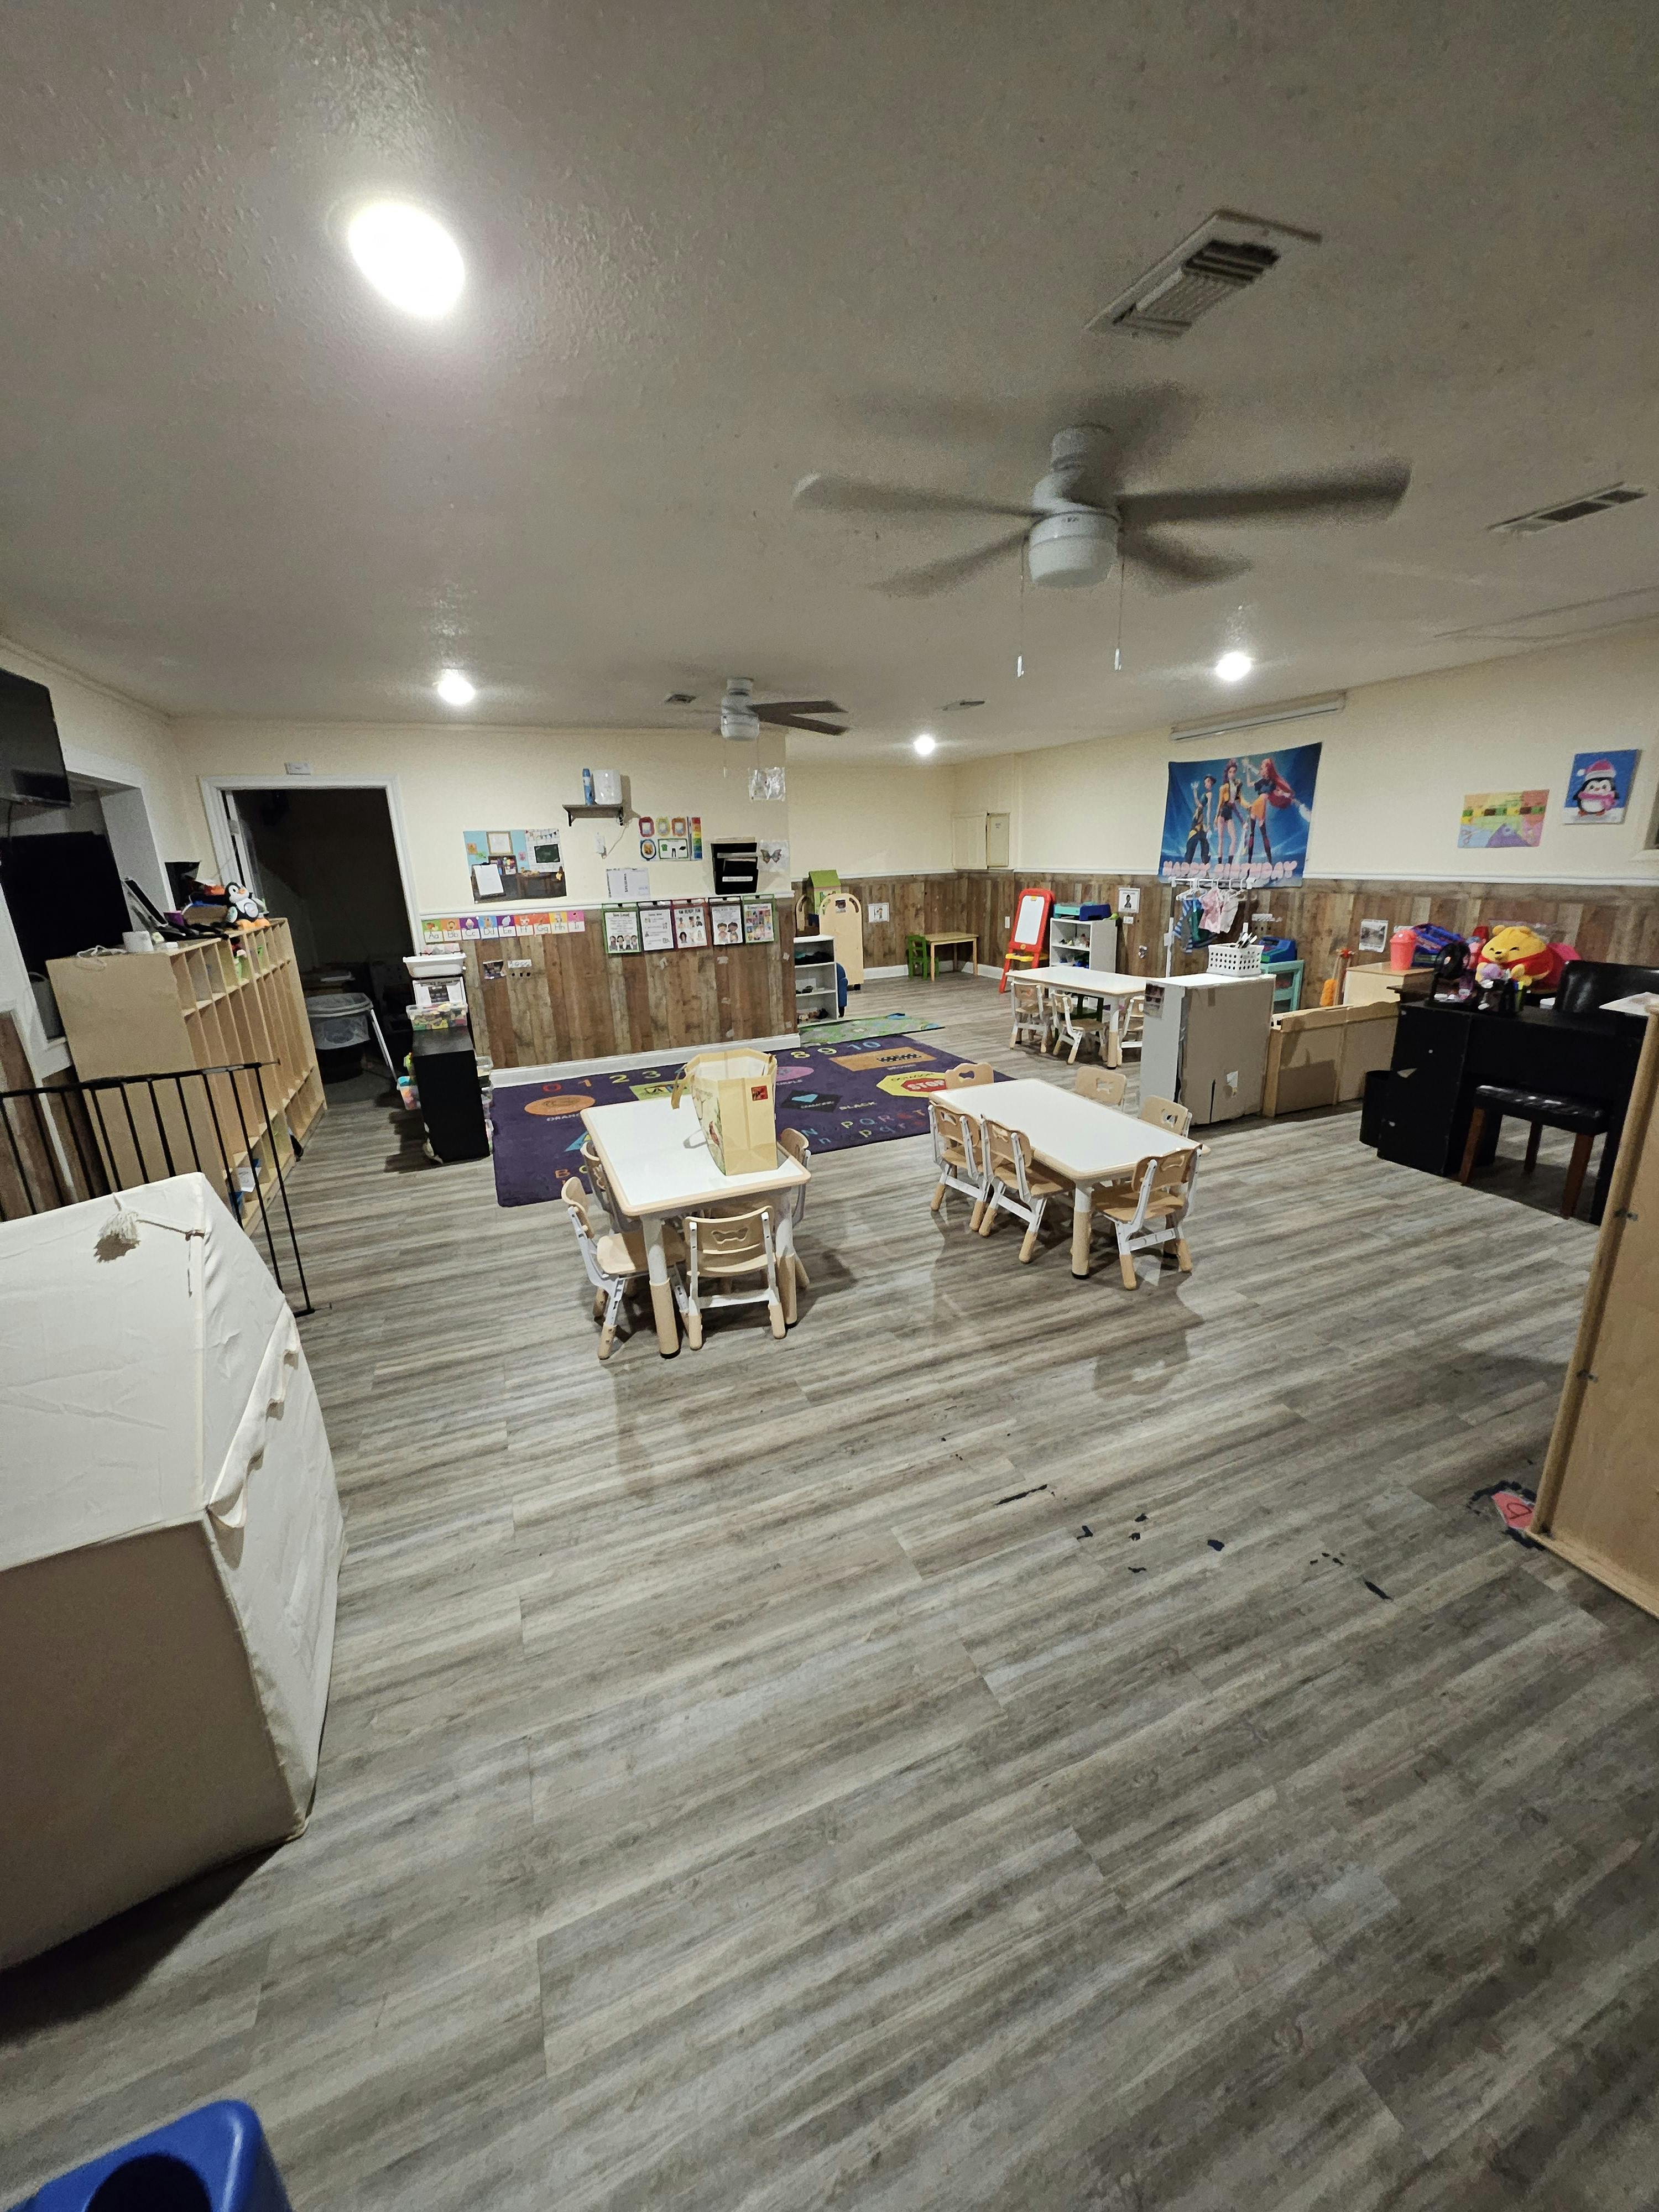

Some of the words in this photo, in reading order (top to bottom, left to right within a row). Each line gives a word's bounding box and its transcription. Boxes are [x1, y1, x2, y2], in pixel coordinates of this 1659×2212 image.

[1162, 860, 1211, 878] HAPPY
[1214, 860, 1298, 879] BIRTHDAY
[847, 1041, 881, 1050] 10
[542, 1083, 562, 1092] 0
[578, 1079, 592, 1087] 1
[609, 1074, 630, 1083] 2
[907, 1080, 945, 1090] STOP
[839, 1102, 877, 1110] BLACK
[546, 1113, 580, 1121] ORAN
[801, 1128, 818, 1136] N
[555, 1169, 570, 1178] B
